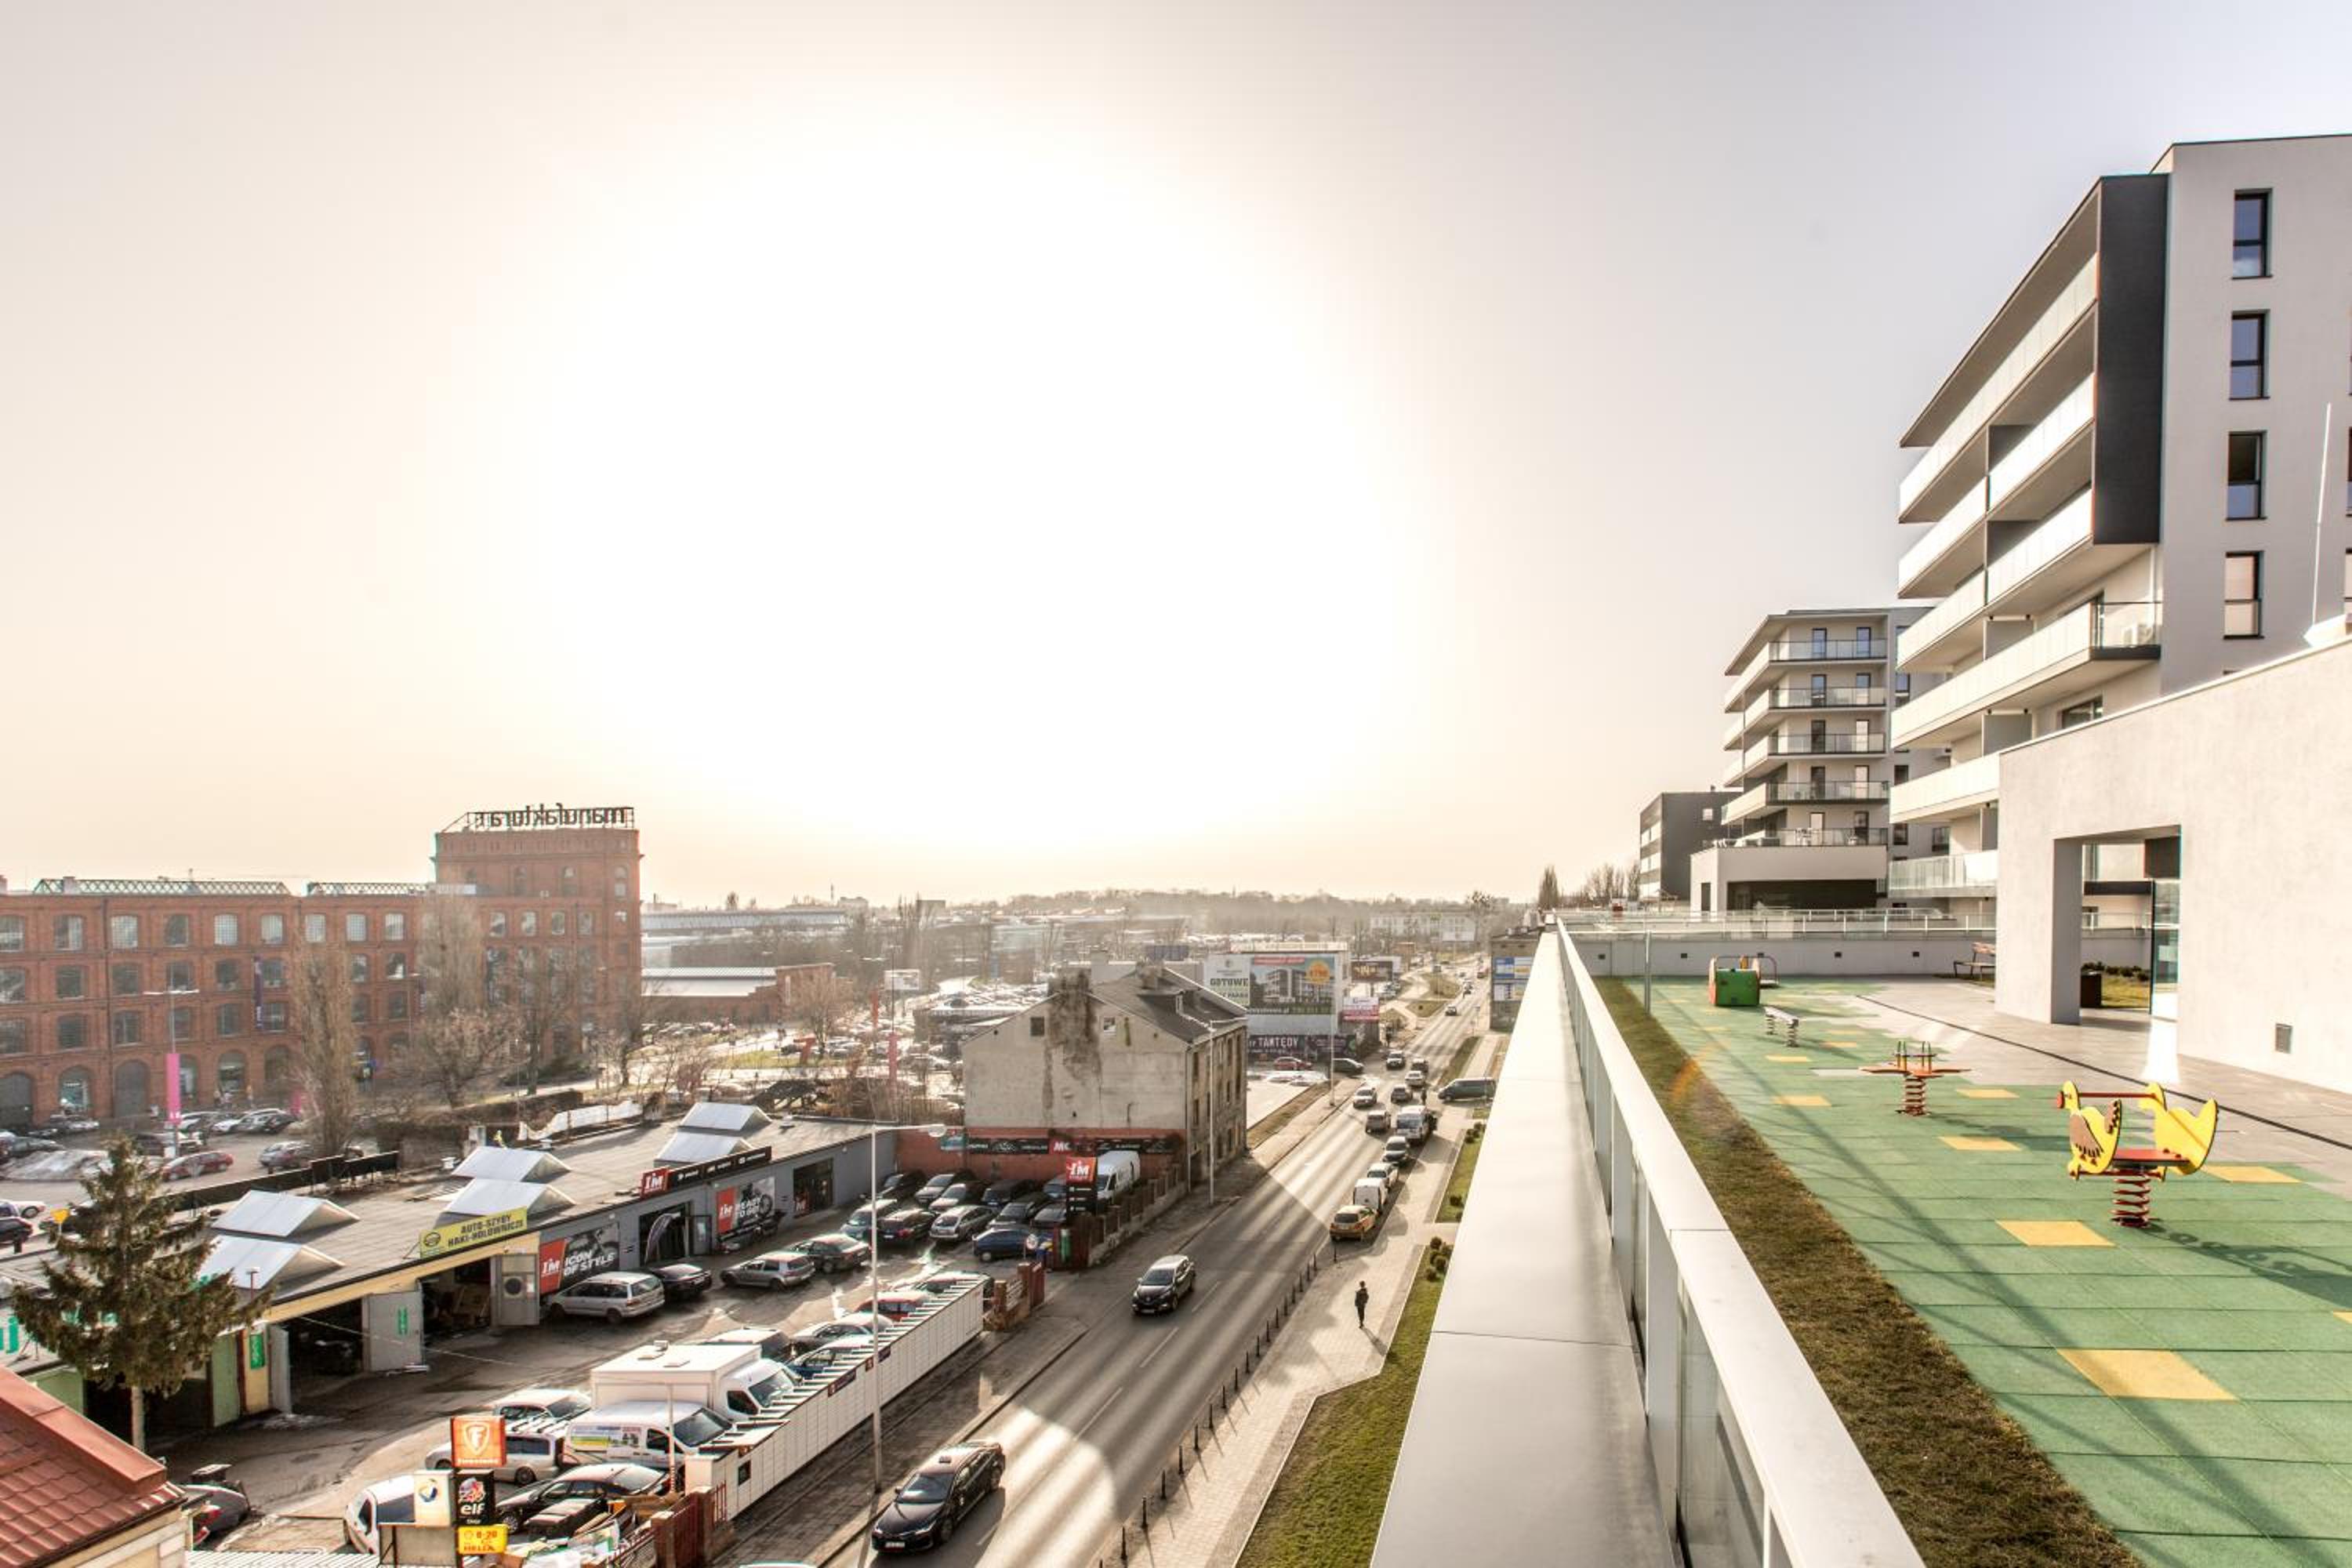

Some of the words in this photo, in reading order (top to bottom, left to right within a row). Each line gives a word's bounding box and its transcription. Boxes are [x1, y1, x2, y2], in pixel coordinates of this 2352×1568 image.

[1210, 978, 1248, 986] GOTOWE
[565, 1250, 593, 1266] ICON
[580, 1252, 615, 1271] STYLE
[461, 1504, 485, 1515] elf
